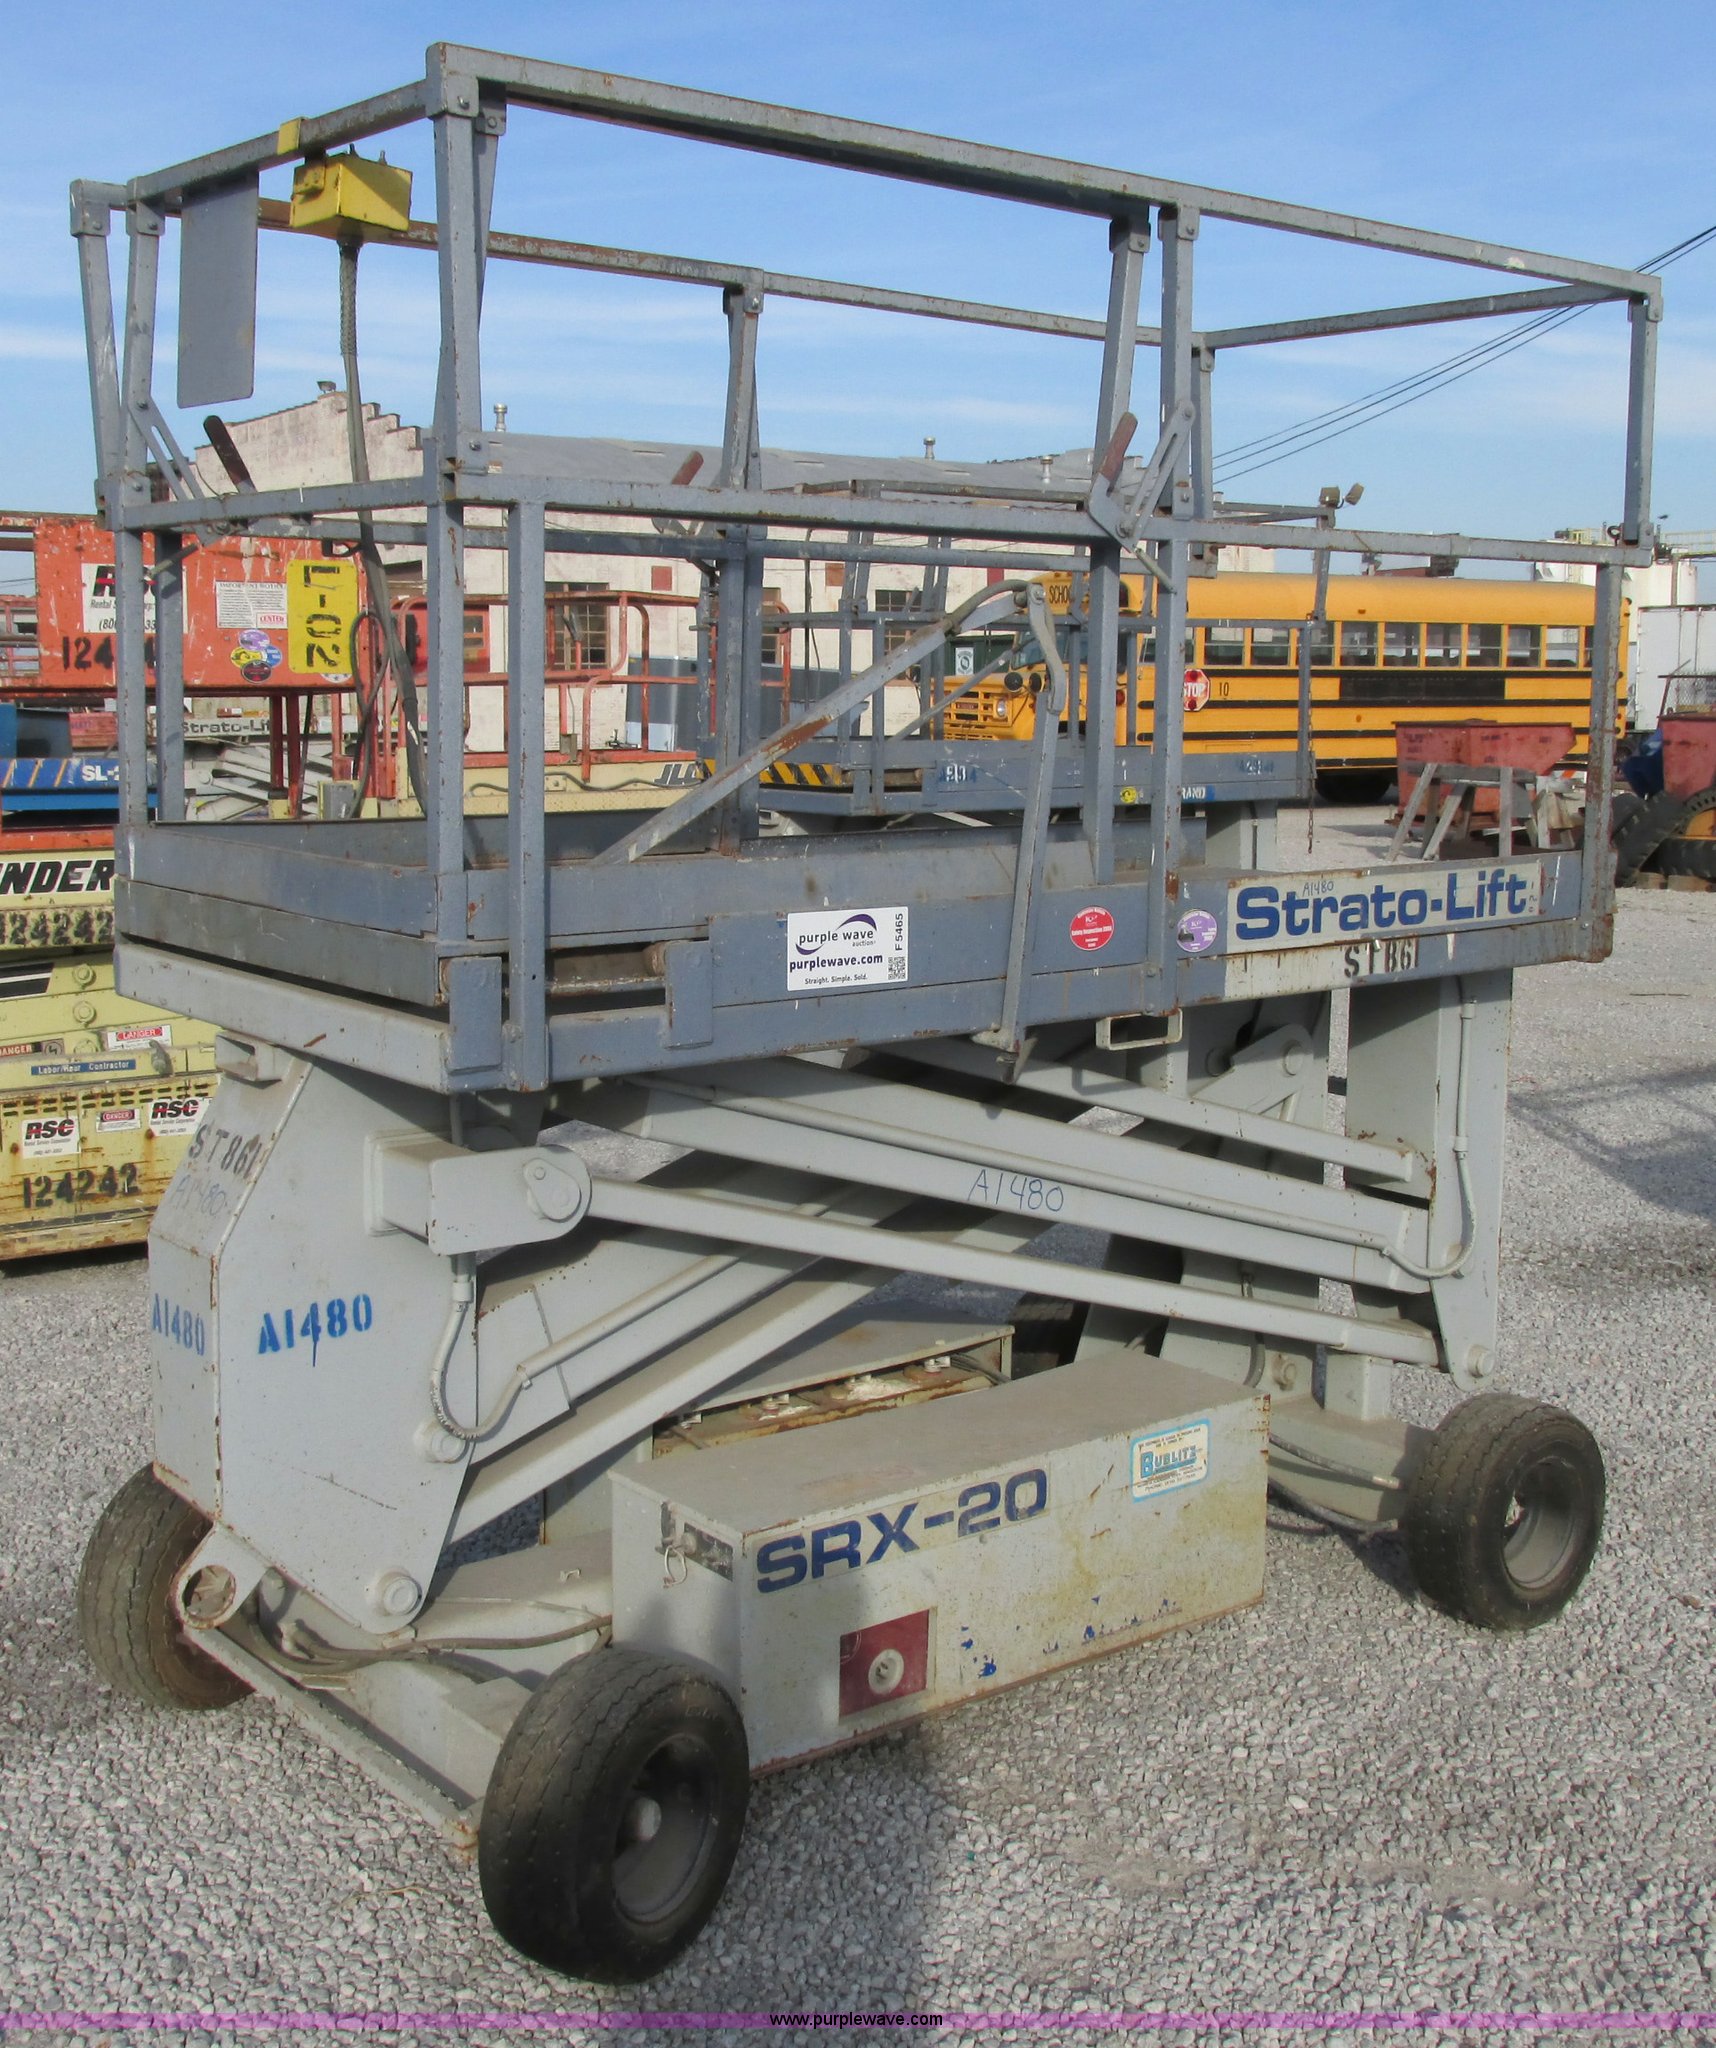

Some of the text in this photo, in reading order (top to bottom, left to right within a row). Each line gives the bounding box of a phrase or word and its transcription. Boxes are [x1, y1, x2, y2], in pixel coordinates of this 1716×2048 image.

[1219, 682, 1230, 697] 10
[0, 859, 115, 895] NDER
[1302, 880, 1335, 898] A1480
[1235, 868, 1527, 941] Strato-Lift
[799, 930, 874, 945] purple wave
[895, 913, 904, 942] 5465
[789, 955, 883, 973] purplewave.com
[804, 976, 829, 985] Straight.
[831, 975, 853, 983] Simple.
[151, 1099, 199, 1119] RSC
[25, 1118, 75, 1139] RSC
[23, 1162, 141, 1209] 124242
[968, 1169, 1064, 1212] A1480
[756, 1468, 1048, 1593] SRX-20
